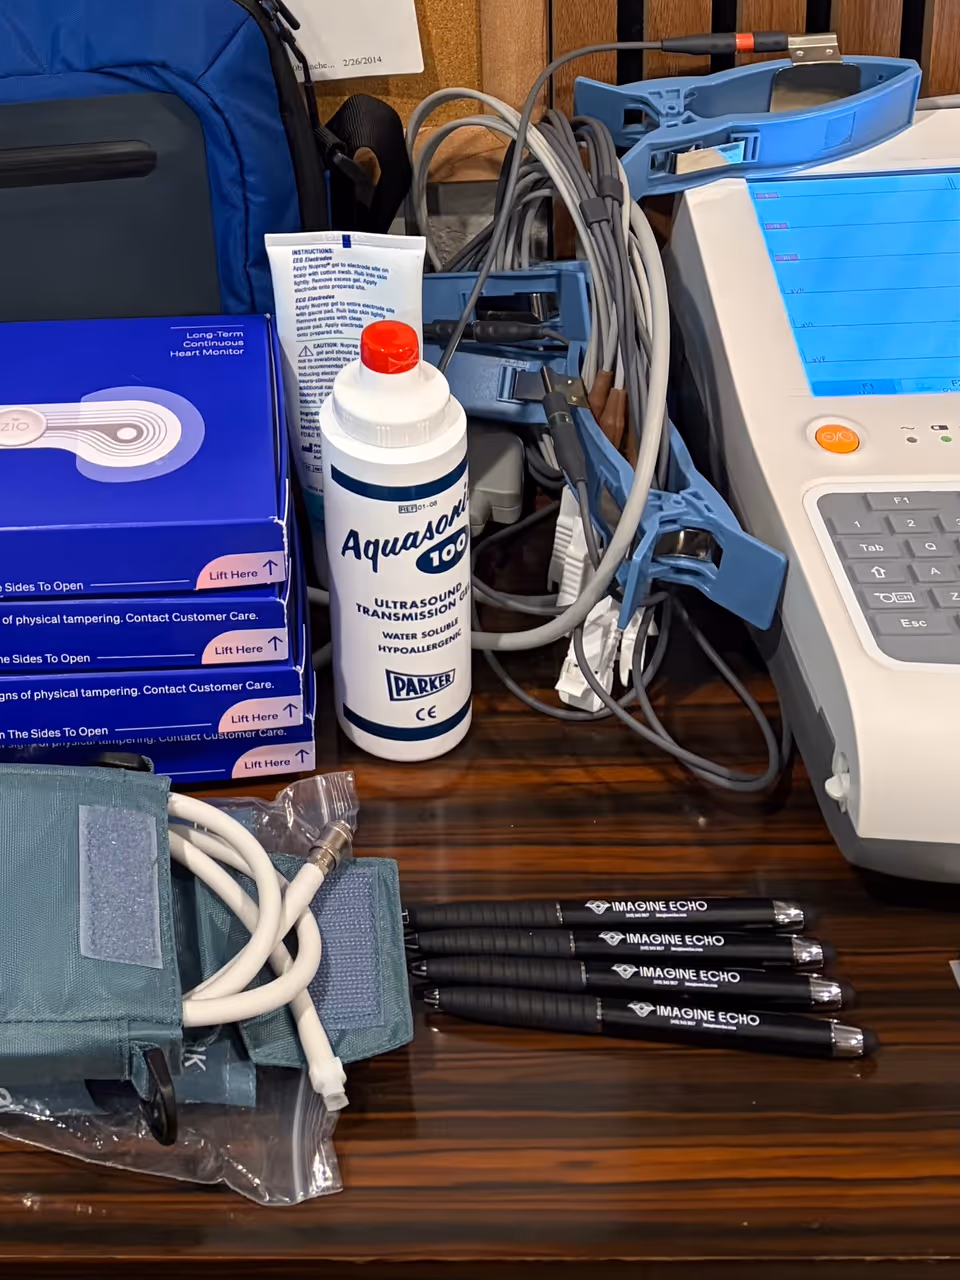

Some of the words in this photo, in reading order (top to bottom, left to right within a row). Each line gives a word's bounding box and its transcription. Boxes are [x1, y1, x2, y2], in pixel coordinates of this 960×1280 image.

[343, 56, 382, 67] 2/26/2014
[183, 338, 244, 348] Continuous
[186, 331, 244, 340] Long-Term
[341, 482, 469, 573] Aquasoni
[430, 532, 466, 567] 100
[859, 543, 884, 552] Tab
[209, 571, 228, 580] Lift
[230, 570, 258, 579] Here
[5, 583, 35, 592] Sides
[37, 581, 51, 591] To
[53, 581, 84, 592] Open
[375, 582, 462, 610] ULTRASOUND
[356, 598, 456, 621] TRANSMISSION
[2, 615, 13, 624] of
[16, 614, 61, 626] physical
[63, 614, 123, 625] tampering.
[126, 613, 170, 623] Contact
[172, 612, 227, 622] Customer
[230, 611, 258, 620] Care.
[900, 619, 928, 628] Esc
[382, 631, 418, 640] WATER
[421, 617, 459, 639] SOLUBLE
[378, 628, 462, 654] HYPOALLERGENIC
[393, 674, 451, 696] PARKER
[612, 901, 667, 912] IMAGINE
[669, 901, 707, 911] ECHO
[656, 1005, 715, 1021] IMAGINE
[718, 1012, 760, 1026] ECHO
